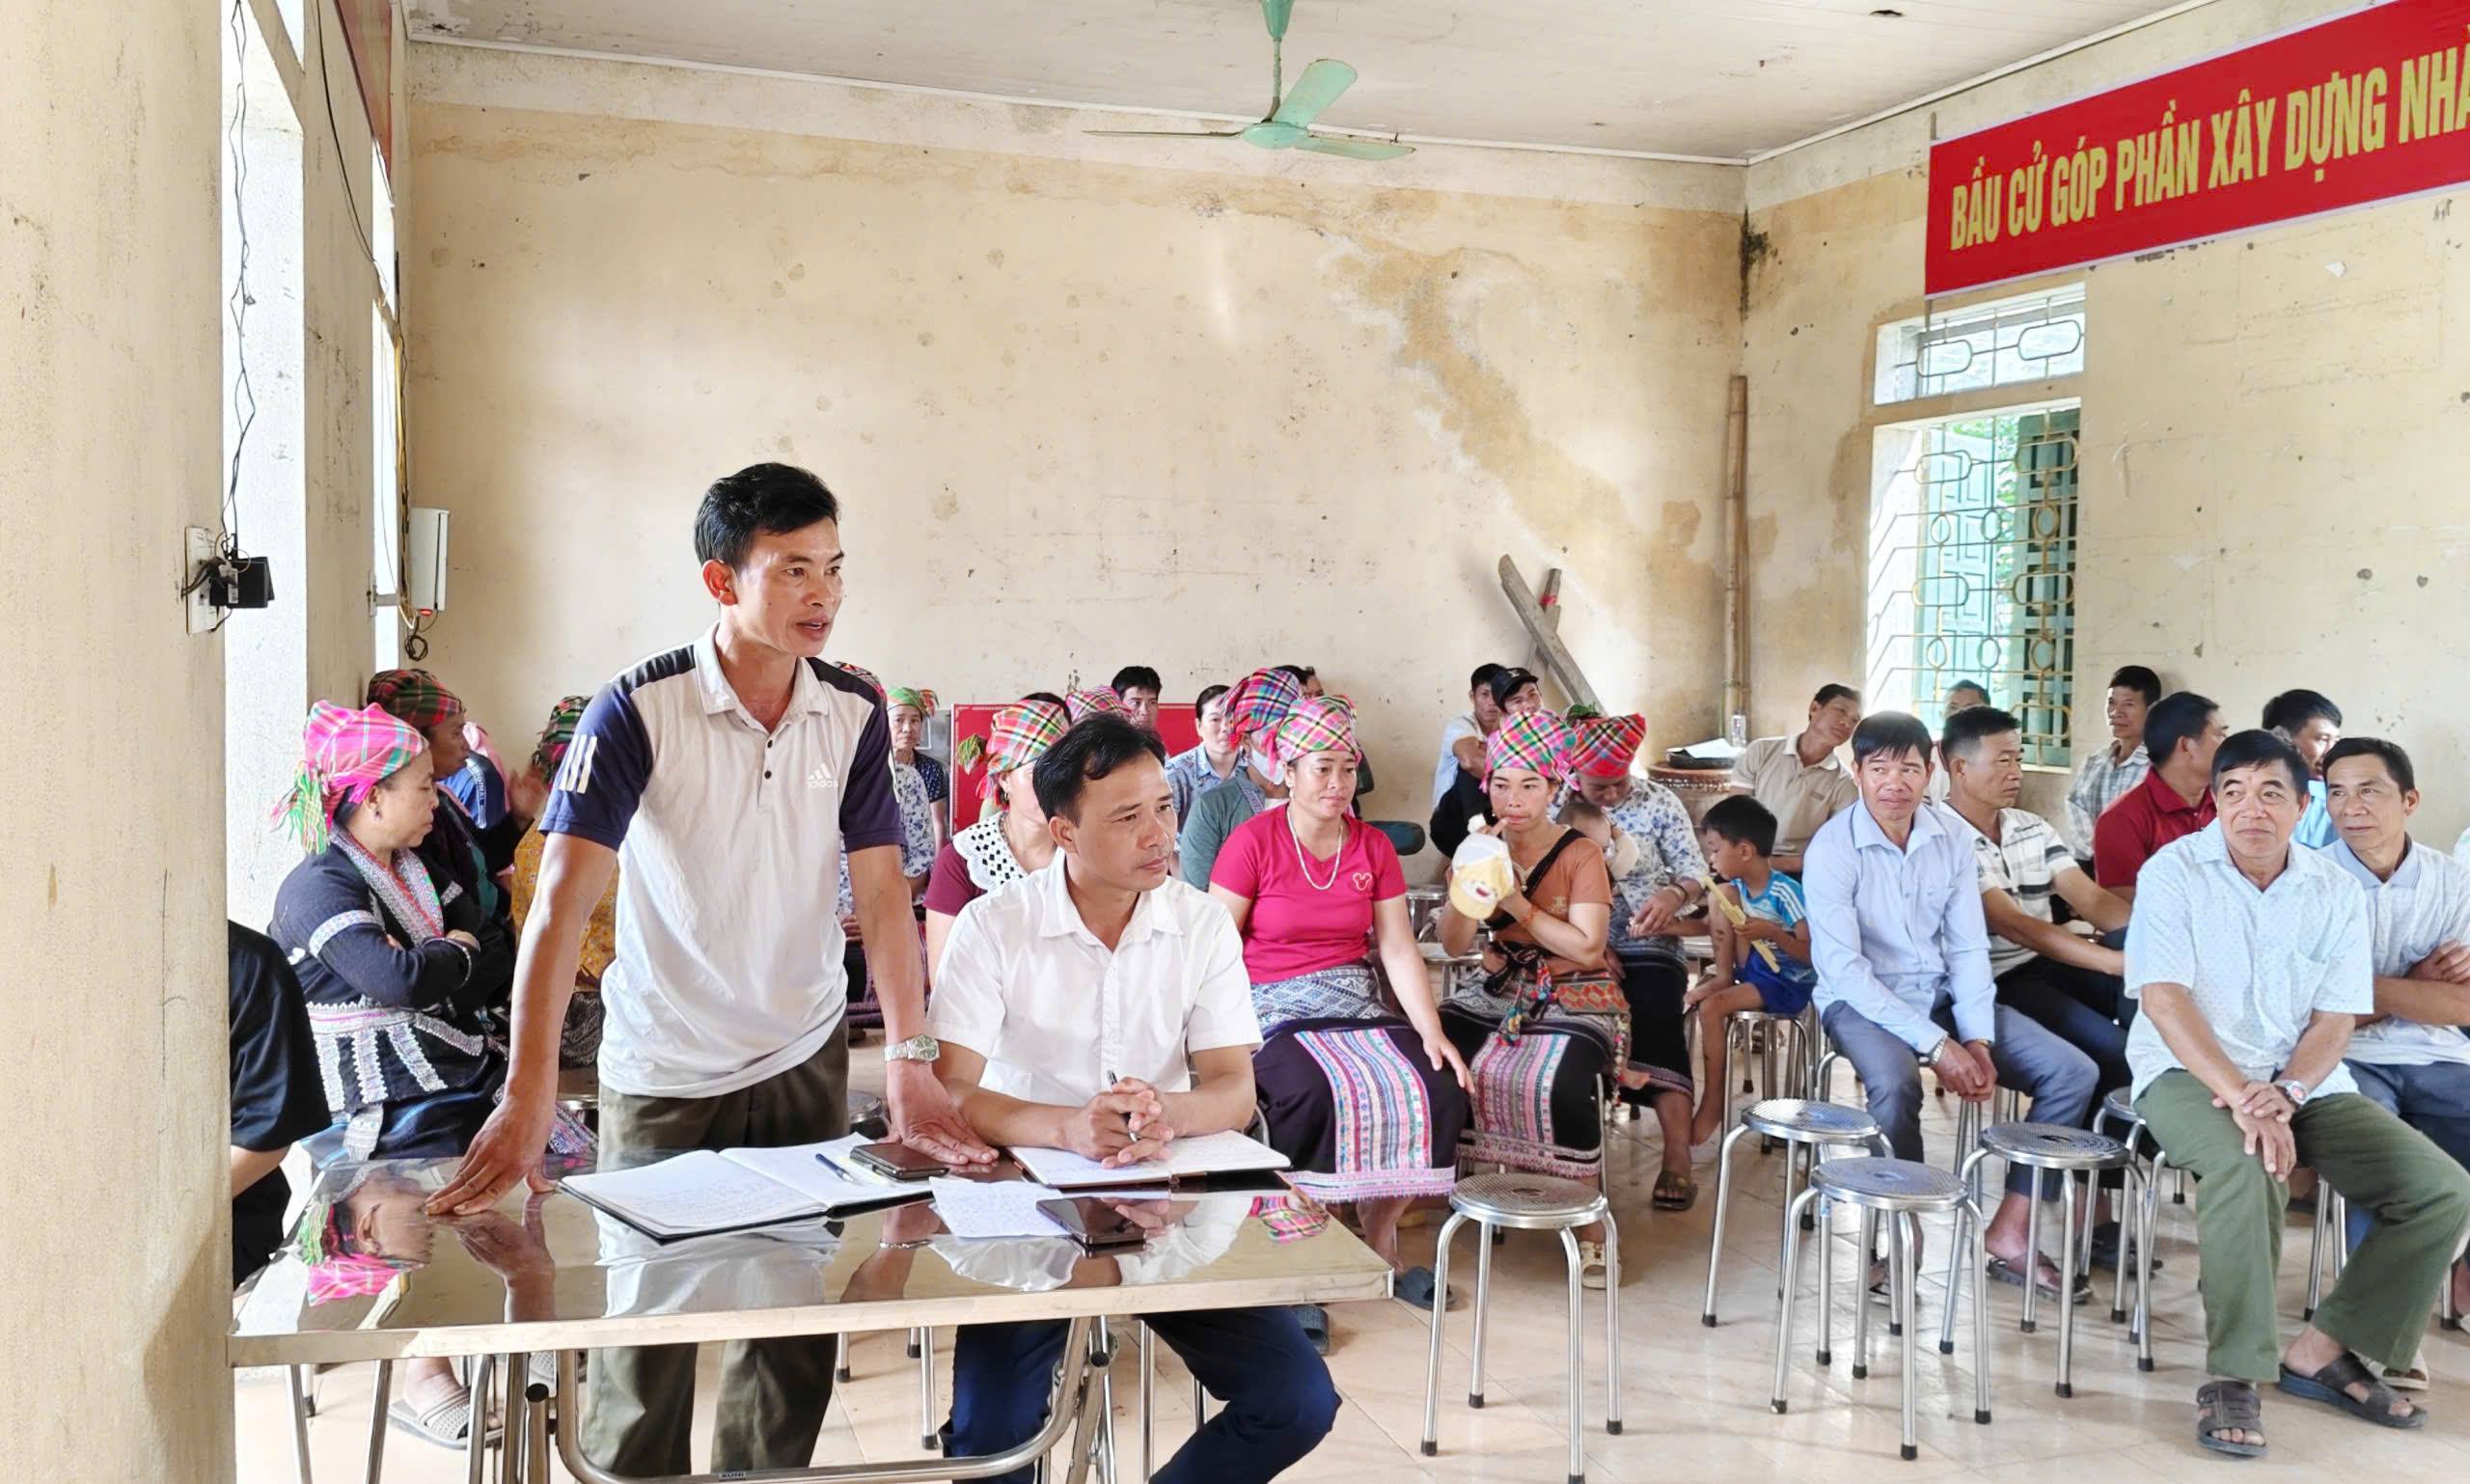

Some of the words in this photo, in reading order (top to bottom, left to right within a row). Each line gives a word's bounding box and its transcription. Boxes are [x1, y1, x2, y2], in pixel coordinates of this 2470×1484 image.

[1951, 156, 2002, 250] BẦU
[2008, 140, 2047, 236] CỬ
[2051, 135, 2107, 227] GÓP
[2115, 99, 2201, 211] PHẦN
[2208, 88, 2276, 189] XÂY
[2285, 67, 2387, 183] DỰNG
